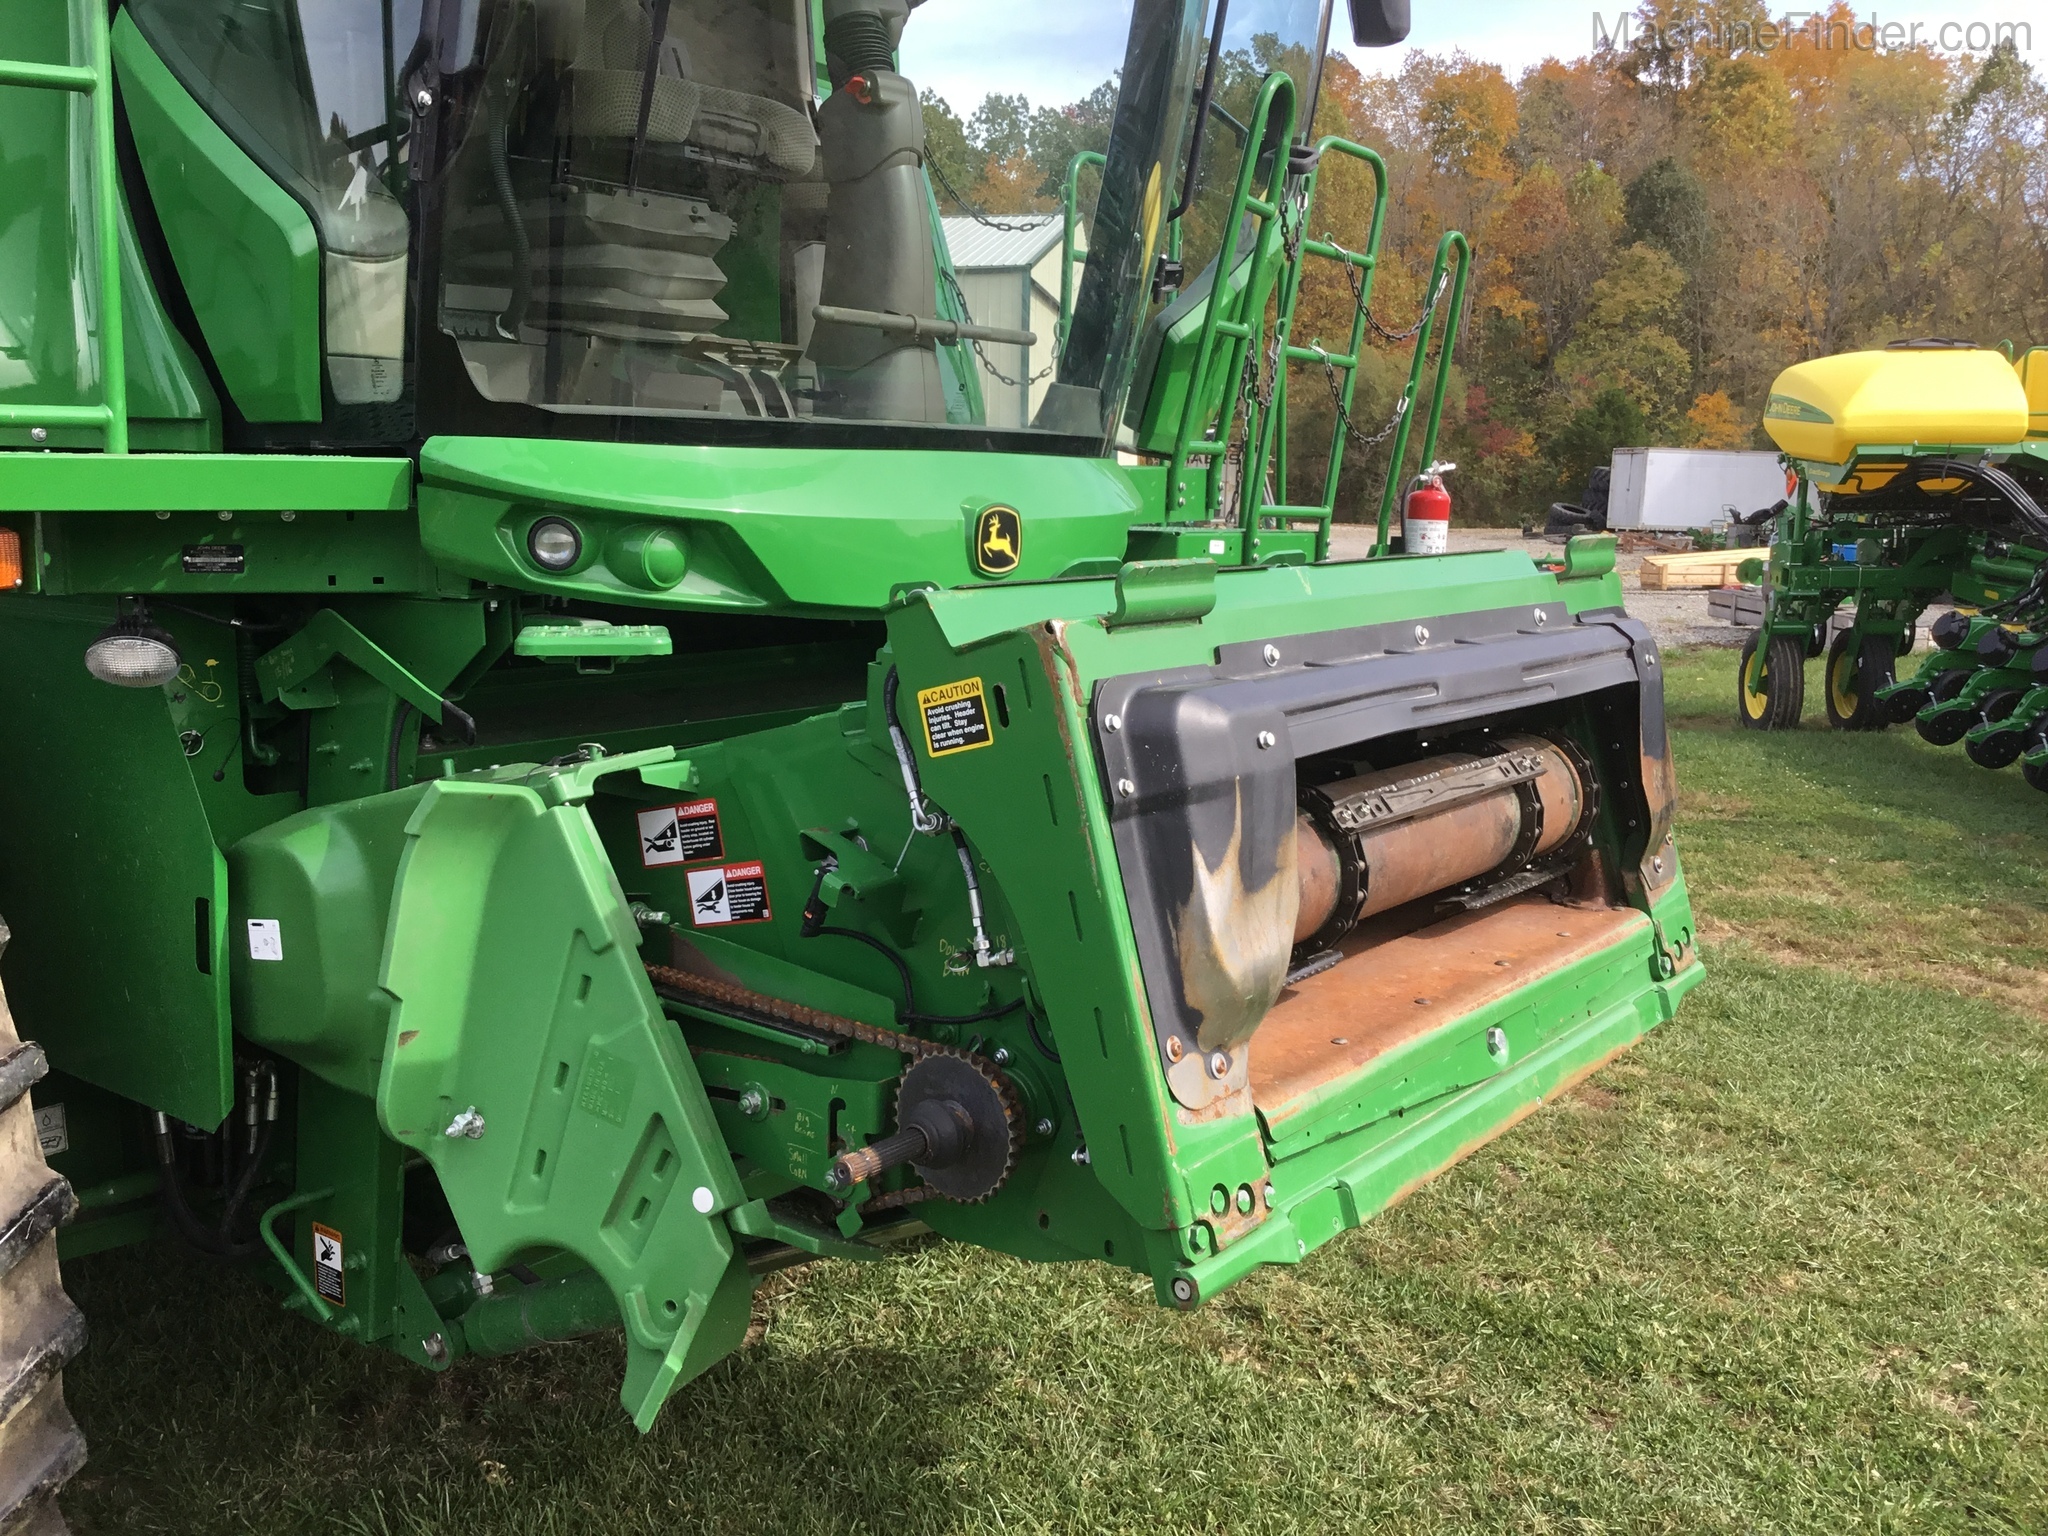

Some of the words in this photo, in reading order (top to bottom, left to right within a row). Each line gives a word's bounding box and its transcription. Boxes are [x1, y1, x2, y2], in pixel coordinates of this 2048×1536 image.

[930, 681, 979, 702] CAUTION
[927, 706, 945, 716] Avoid
[944, 700, 972, 712] crushing
[954, 708, 975, 718] Header
[953, 719, 967, 727] Stay
[931, 731, 946, 740] clear
[947, 727, 963, 736] when
[964, 723, 985, 734] engine
[933, 740, 940, 748] is
[683, 802, 714, 815] DANGER
[731, 866, 761, 877] DANGER
